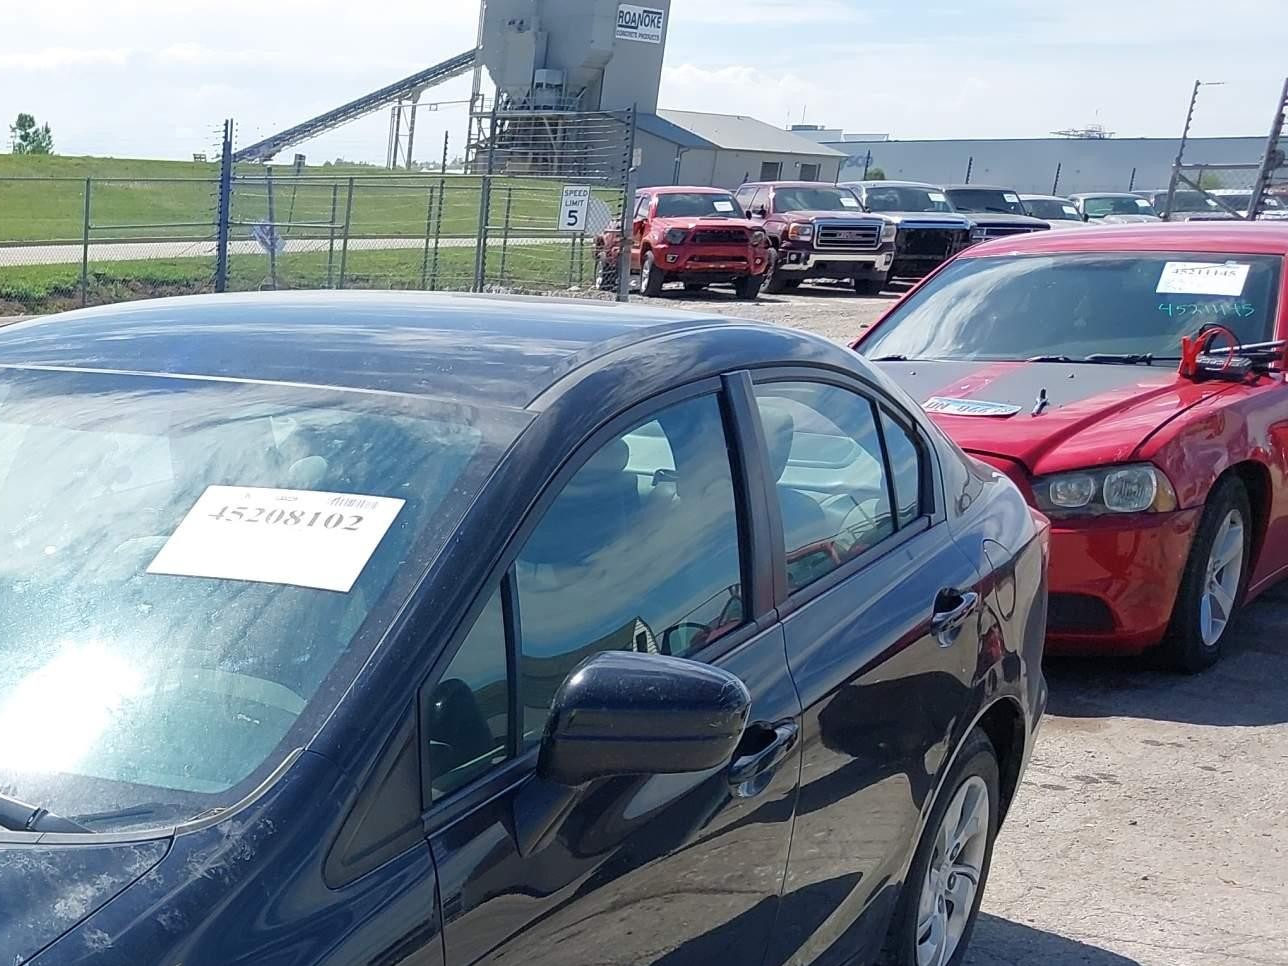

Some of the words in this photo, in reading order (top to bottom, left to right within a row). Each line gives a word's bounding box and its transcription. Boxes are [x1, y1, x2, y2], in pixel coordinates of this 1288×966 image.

[618, 10, 663, 29] ROANOKE
[564, 189, 588, 197] SPEED
[565, 199, 584, 207] LIMIT
[567, 210, 578, 226] 5
[1158, 303, 1255, 317] 45211145
[208, 504, 365, 531] 45208102
